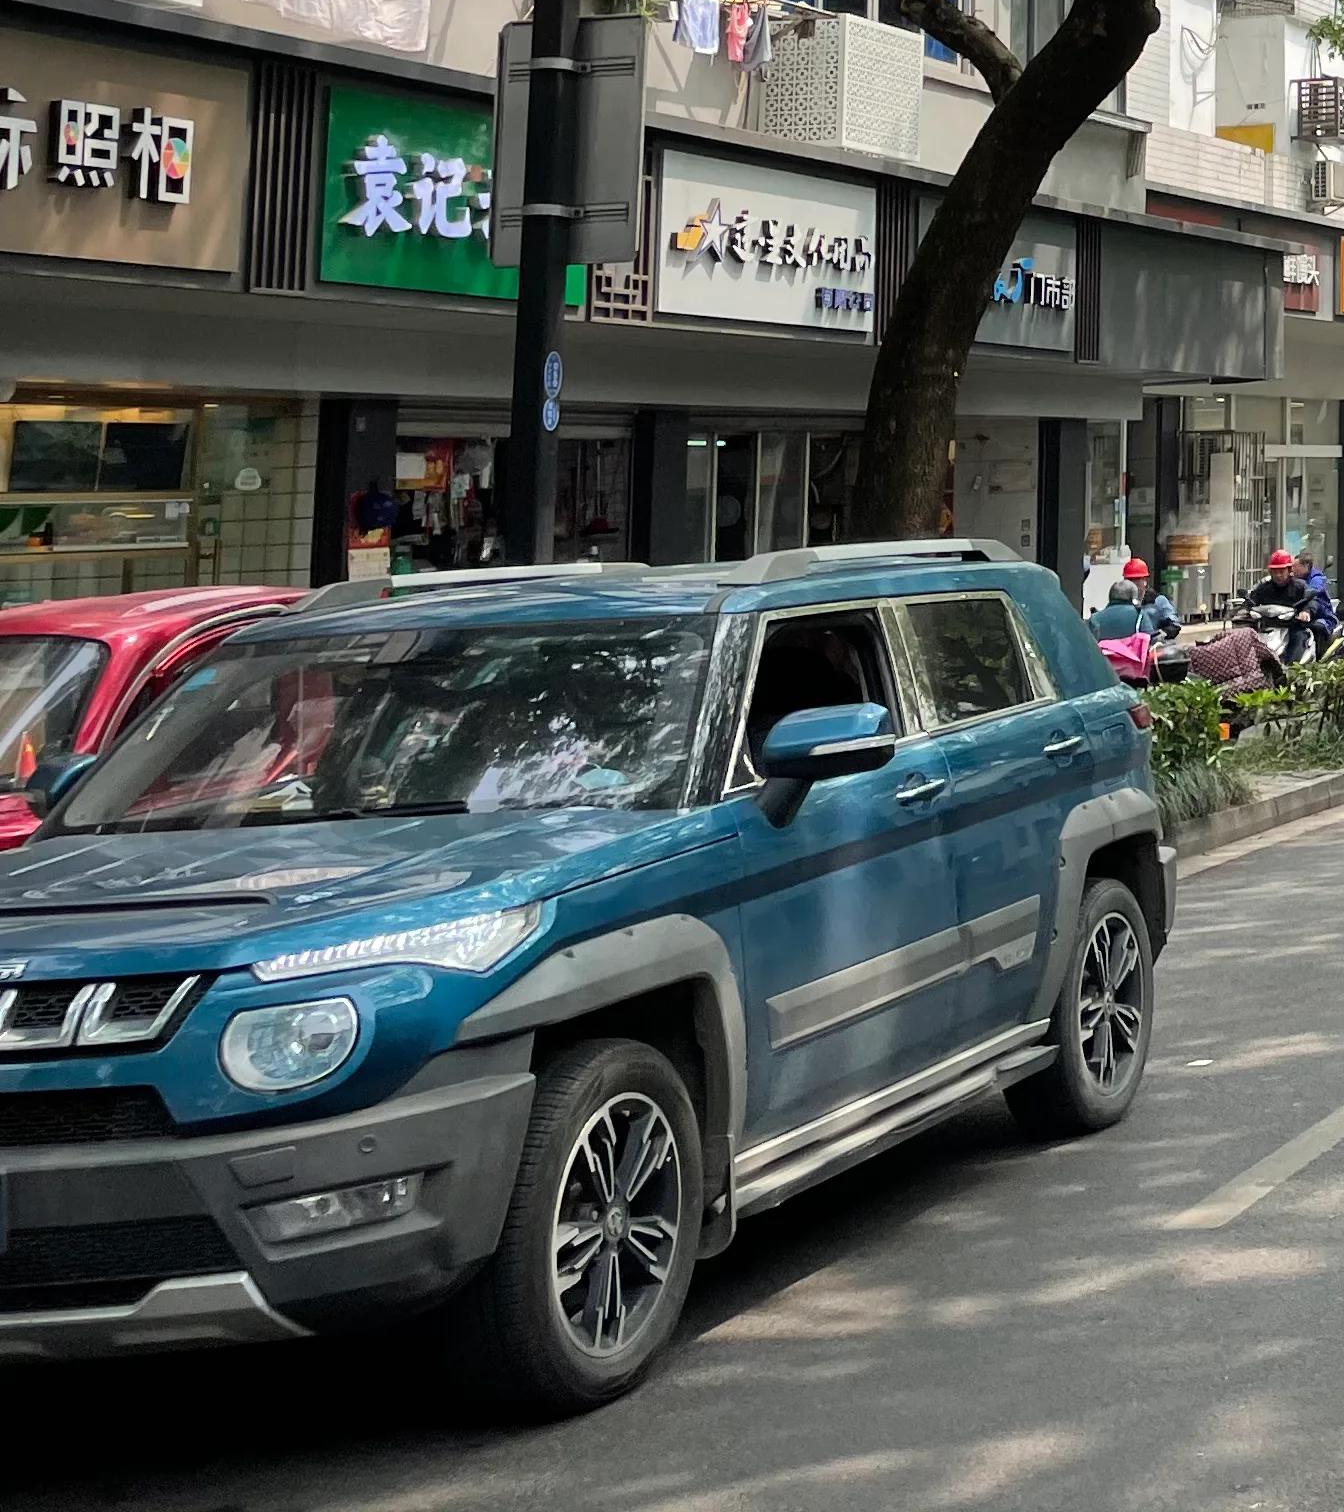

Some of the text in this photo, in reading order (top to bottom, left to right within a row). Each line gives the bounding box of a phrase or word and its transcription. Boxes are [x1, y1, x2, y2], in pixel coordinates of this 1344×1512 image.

[351, 134, 491, 240] 袁记
[1028, 272, 1076, 309] 门市部
